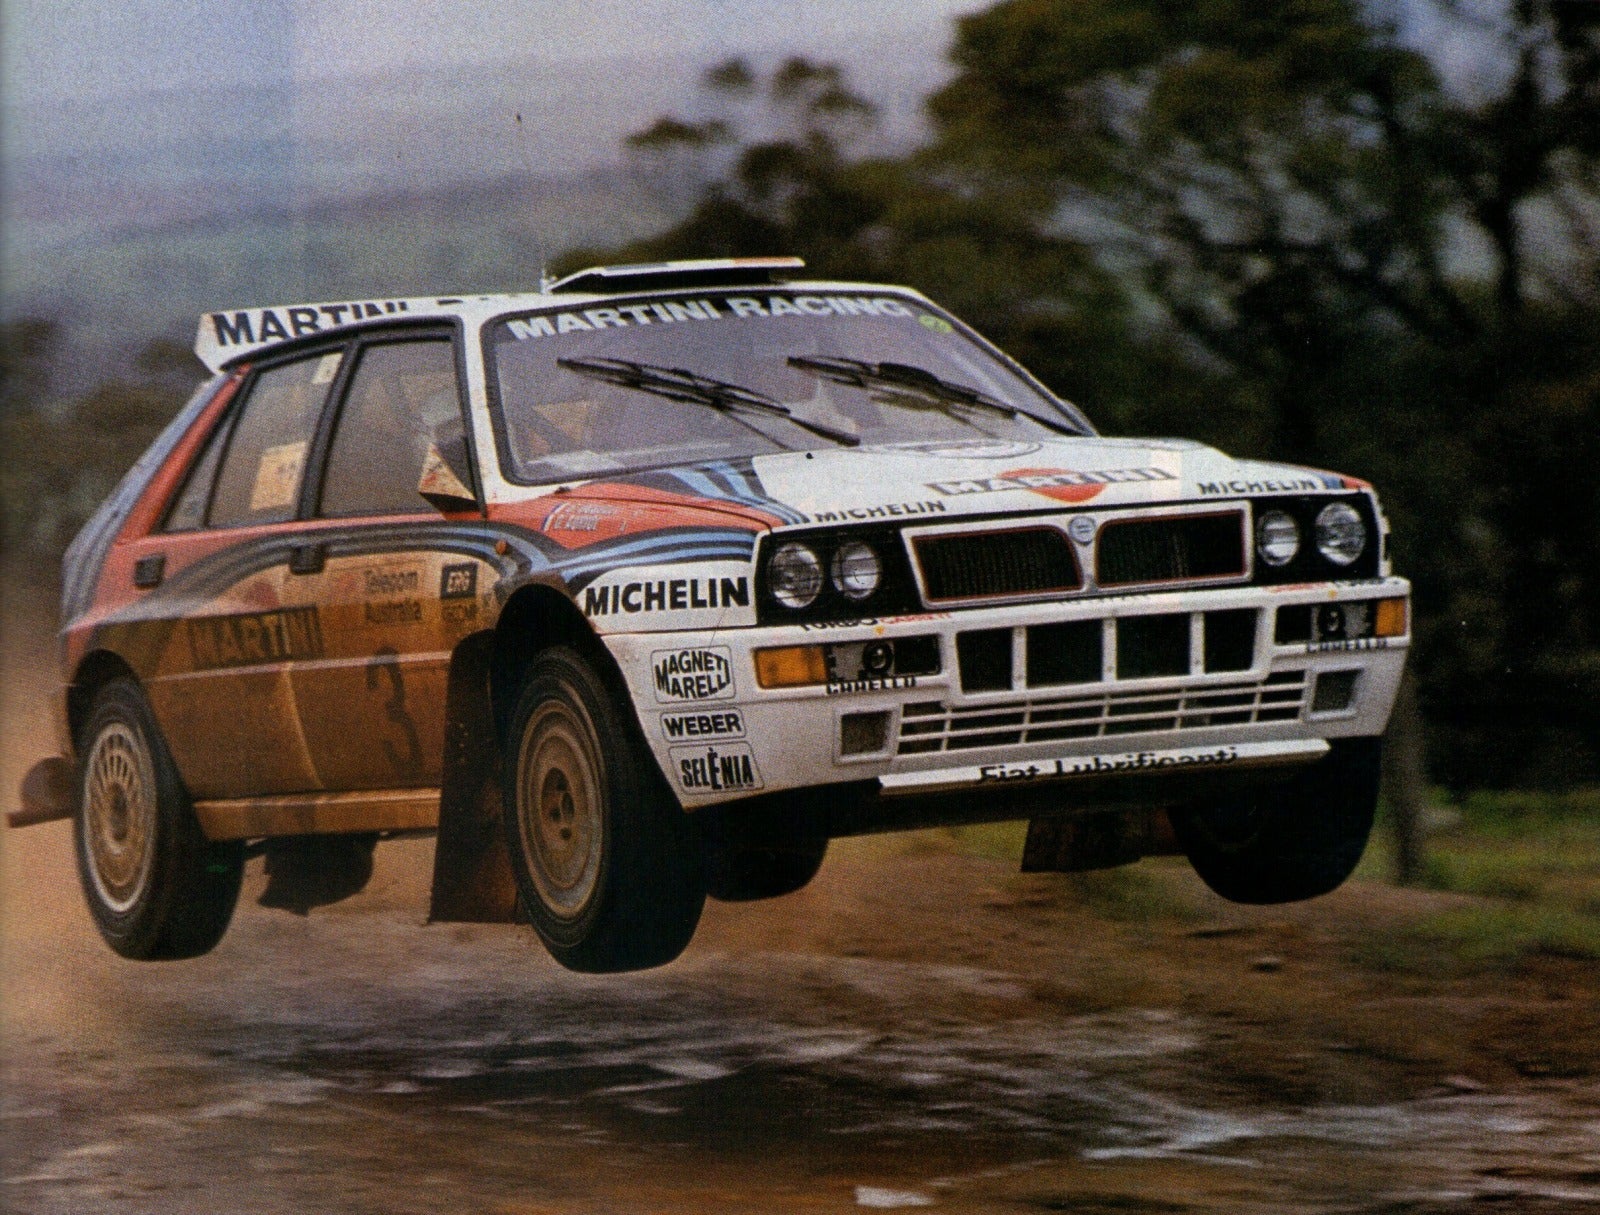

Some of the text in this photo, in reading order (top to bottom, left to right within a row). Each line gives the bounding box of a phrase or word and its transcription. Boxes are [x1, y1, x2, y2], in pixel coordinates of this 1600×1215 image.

[507, 296, 912, 340] MARTINI RACING
[1197, 478, 1318, 495] MICHELIN
[816, 499, 946, 523] MICHELIN
[585, 576, 750, 617] MICHELIN
[188, 605, 323, 671] MARTINI
[655, 650, 730, 682] MAGNETI
[655, 668, 730, 699] MARELLI
[366, 643, 425, 781] 3
[664, 713, 741, 737] WEBER
[979, 746, 1239, 782] Fiat Lubrificanti
